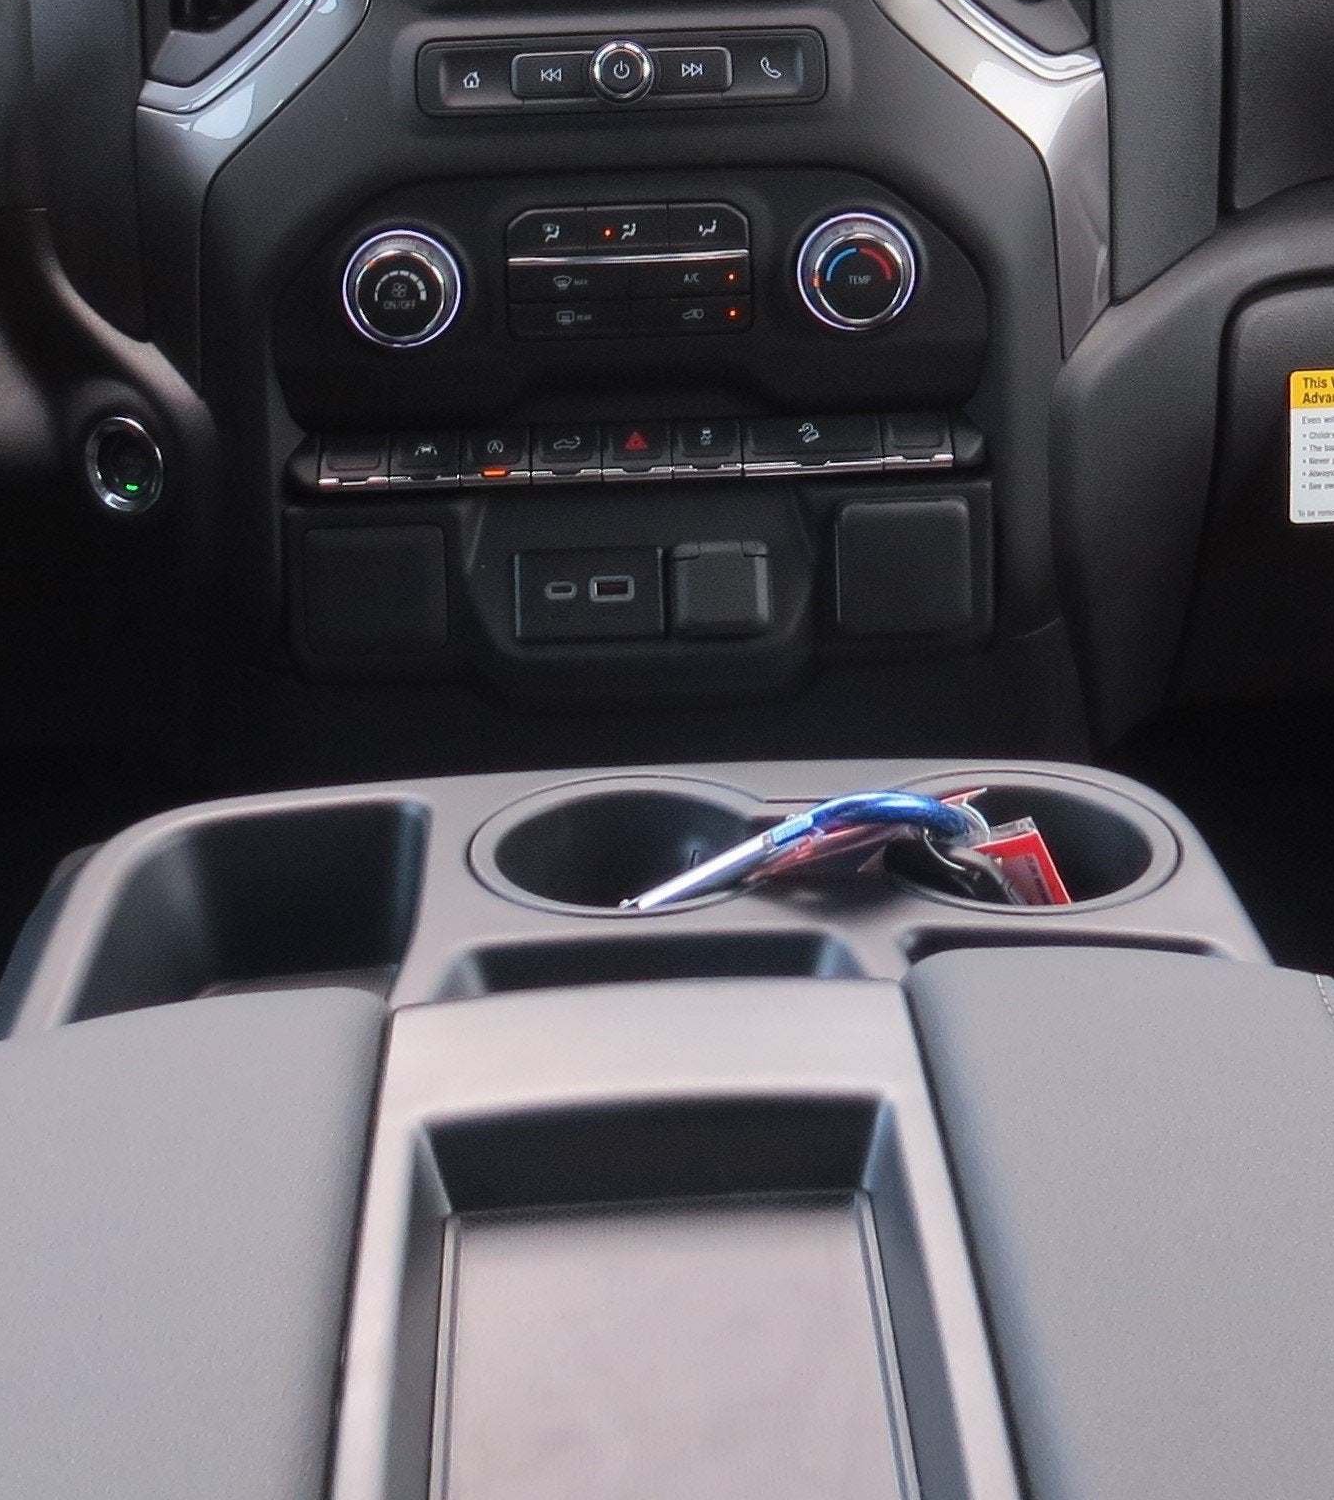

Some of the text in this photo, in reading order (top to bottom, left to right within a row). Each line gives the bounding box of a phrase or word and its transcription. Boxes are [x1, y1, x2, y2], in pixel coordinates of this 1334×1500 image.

[683, 272, 700, 284] A/C
[383, 300, 416, 310] ON/OFF
[1302, 376, 1328, 389] This
